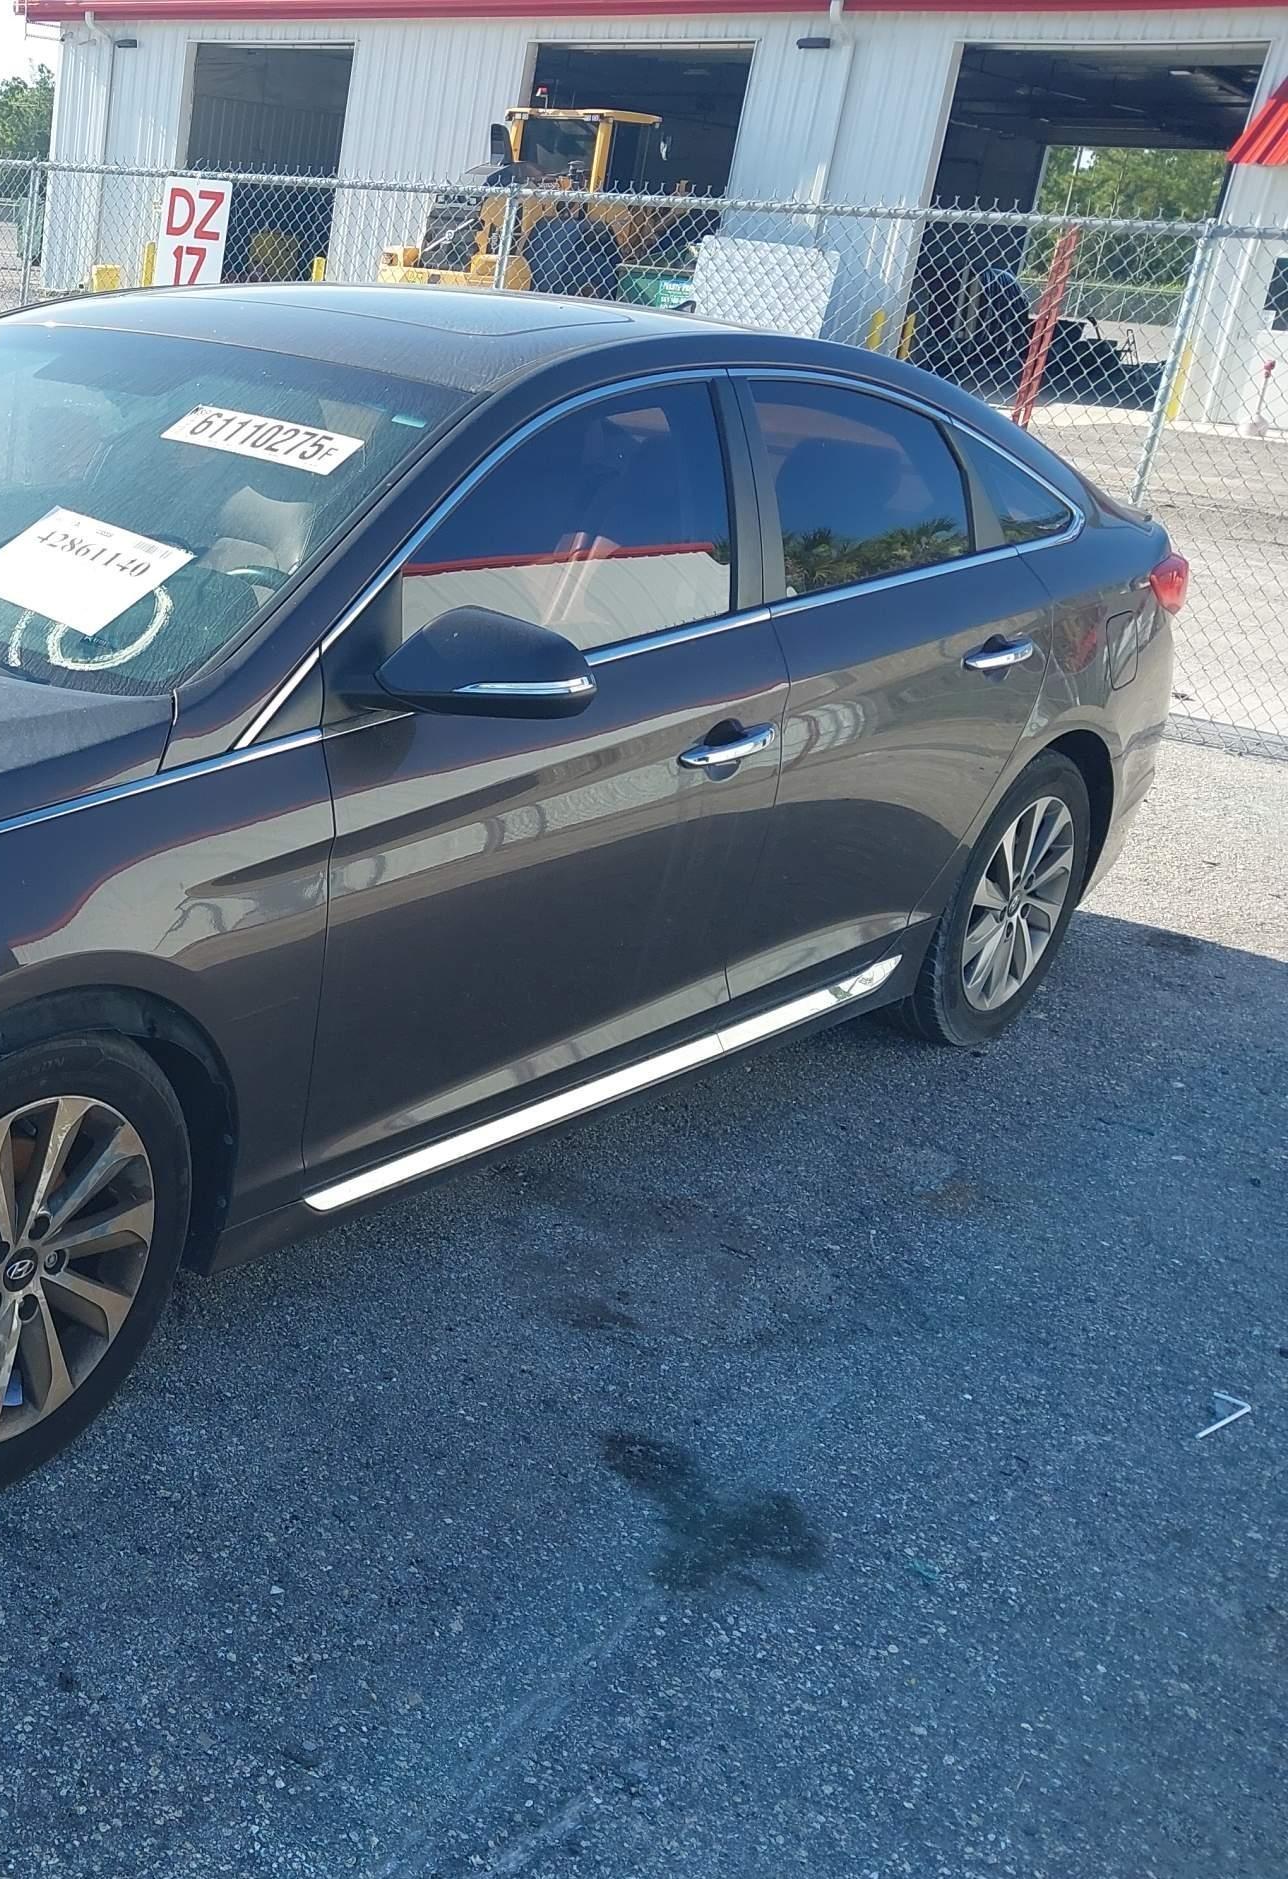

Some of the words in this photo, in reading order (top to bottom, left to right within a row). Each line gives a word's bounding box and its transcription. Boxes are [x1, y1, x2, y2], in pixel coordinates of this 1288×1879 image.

[166, 187, 225, 241] DZ
[172, 245, 206, 287] 17
[36, 529, 152, 578] 42861140
